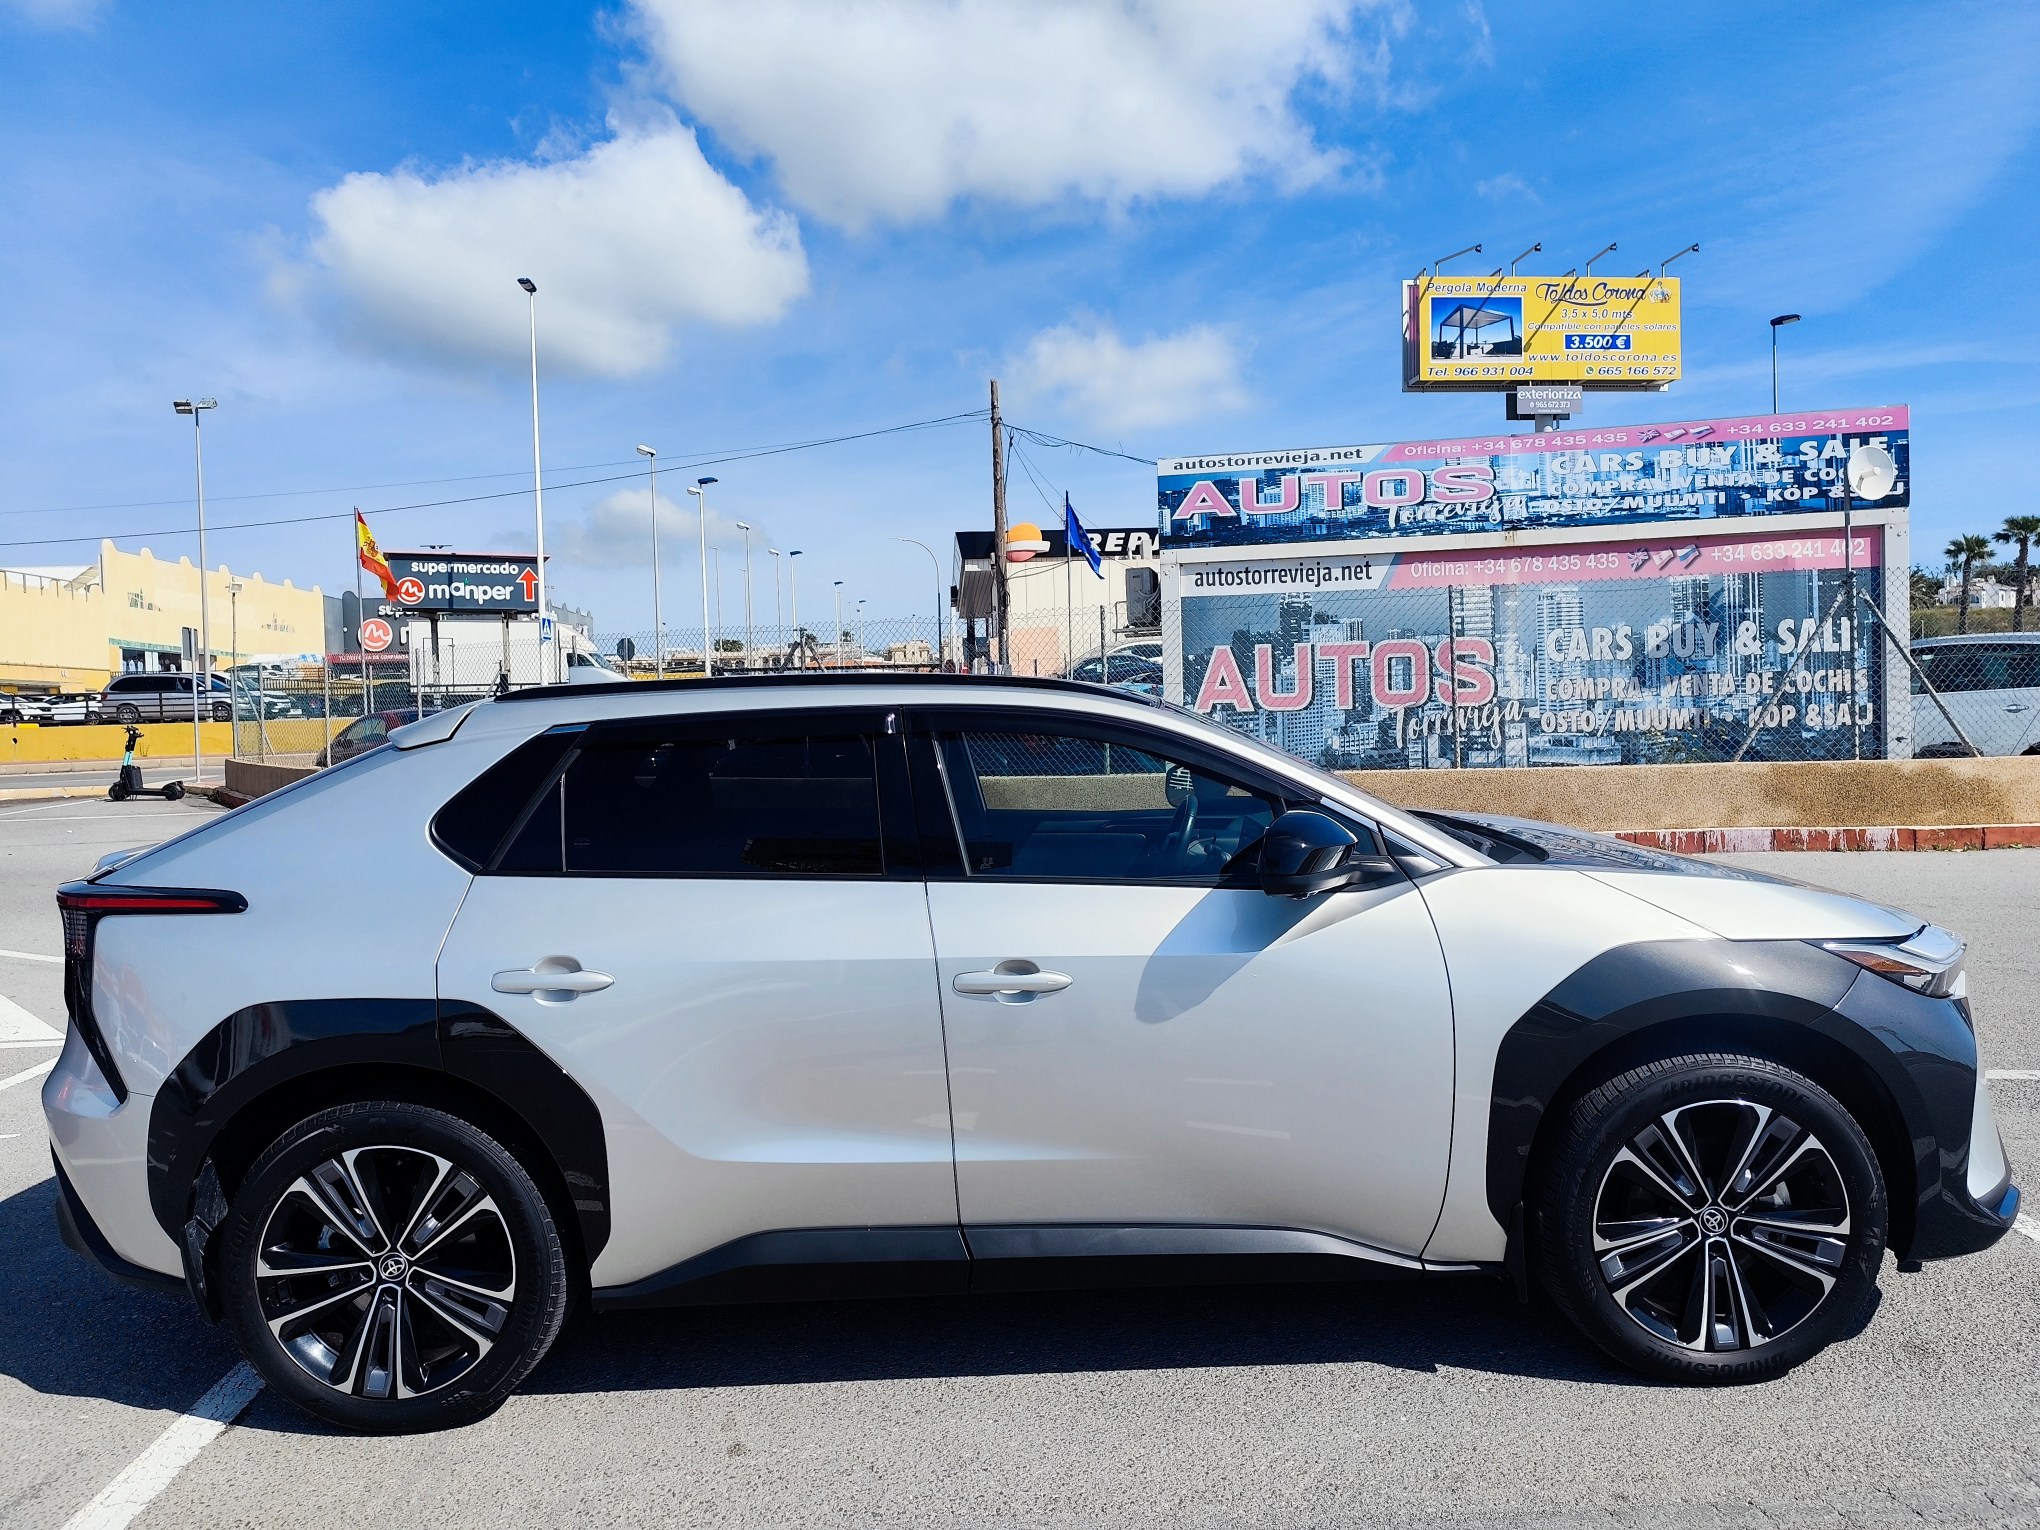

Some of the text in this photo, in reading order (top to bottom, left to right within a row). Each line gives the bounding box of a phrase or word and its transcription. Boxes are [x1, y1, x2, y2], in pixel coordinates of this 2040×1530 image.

[1476, 282, 1527, 292] Moderna
[1536, 281, 1646, 304] Toldos Corona
[1562, 309, 1578, 319] 3,5
[1591, 309, 1608, 319] 5,0
[1528, 322, 1581, 331] Compatible
[1604, 323, 1640, 331] paneles
[1570, 336, 1627, 348] 3.500 €
[1528, 353, 1677, 362] www.toldoscorona.es
[1427, 367, 1534, 376] Tel. 966 931 004
[1598, 367, 1676, 375] 665 166 572
[1518, 388, 1581, 399] exterioriza
[1727, 415, 1893, 435] +34 633 241 402
[1404, 432, 1628, 456] Oficina: +34 678 435 435
[1173, 448, 1363, 471] autostorrevieja.net
[1551, 451, 1645, 474] CARS
[1660, 446, 1737, 468] BUY
[1754, 444, 1783, 463] &
[1678, 471, 1755, 488] VENTA
[1765, 470, 1794, 484] DE
[1172, 466, 1496, 520] AUTOS
[1767, 485, 1818, 502] KÖP
[1710, 538, 1865, 562] +34 633 241 402
[411, 561, 518, 576] supermercado
[1195, 560, 1372, 588] autostorrevieja.net
[1410, 552, 1619, 579] Oficina: +34 678 435 435
[429, 578, 514, 604] manper
[1547, 625, 1633, 663] CARS
[1648, 621, 1720, 660] BUY
[1736, 620, 1763, 656] &
[1194, 637, 1497, 714] AUTOS
[1546, 677, 1642, 700] COMPRA
[1664, 672, 1736, 699] VENTA
[1746, 672, 1773, 694] DE
